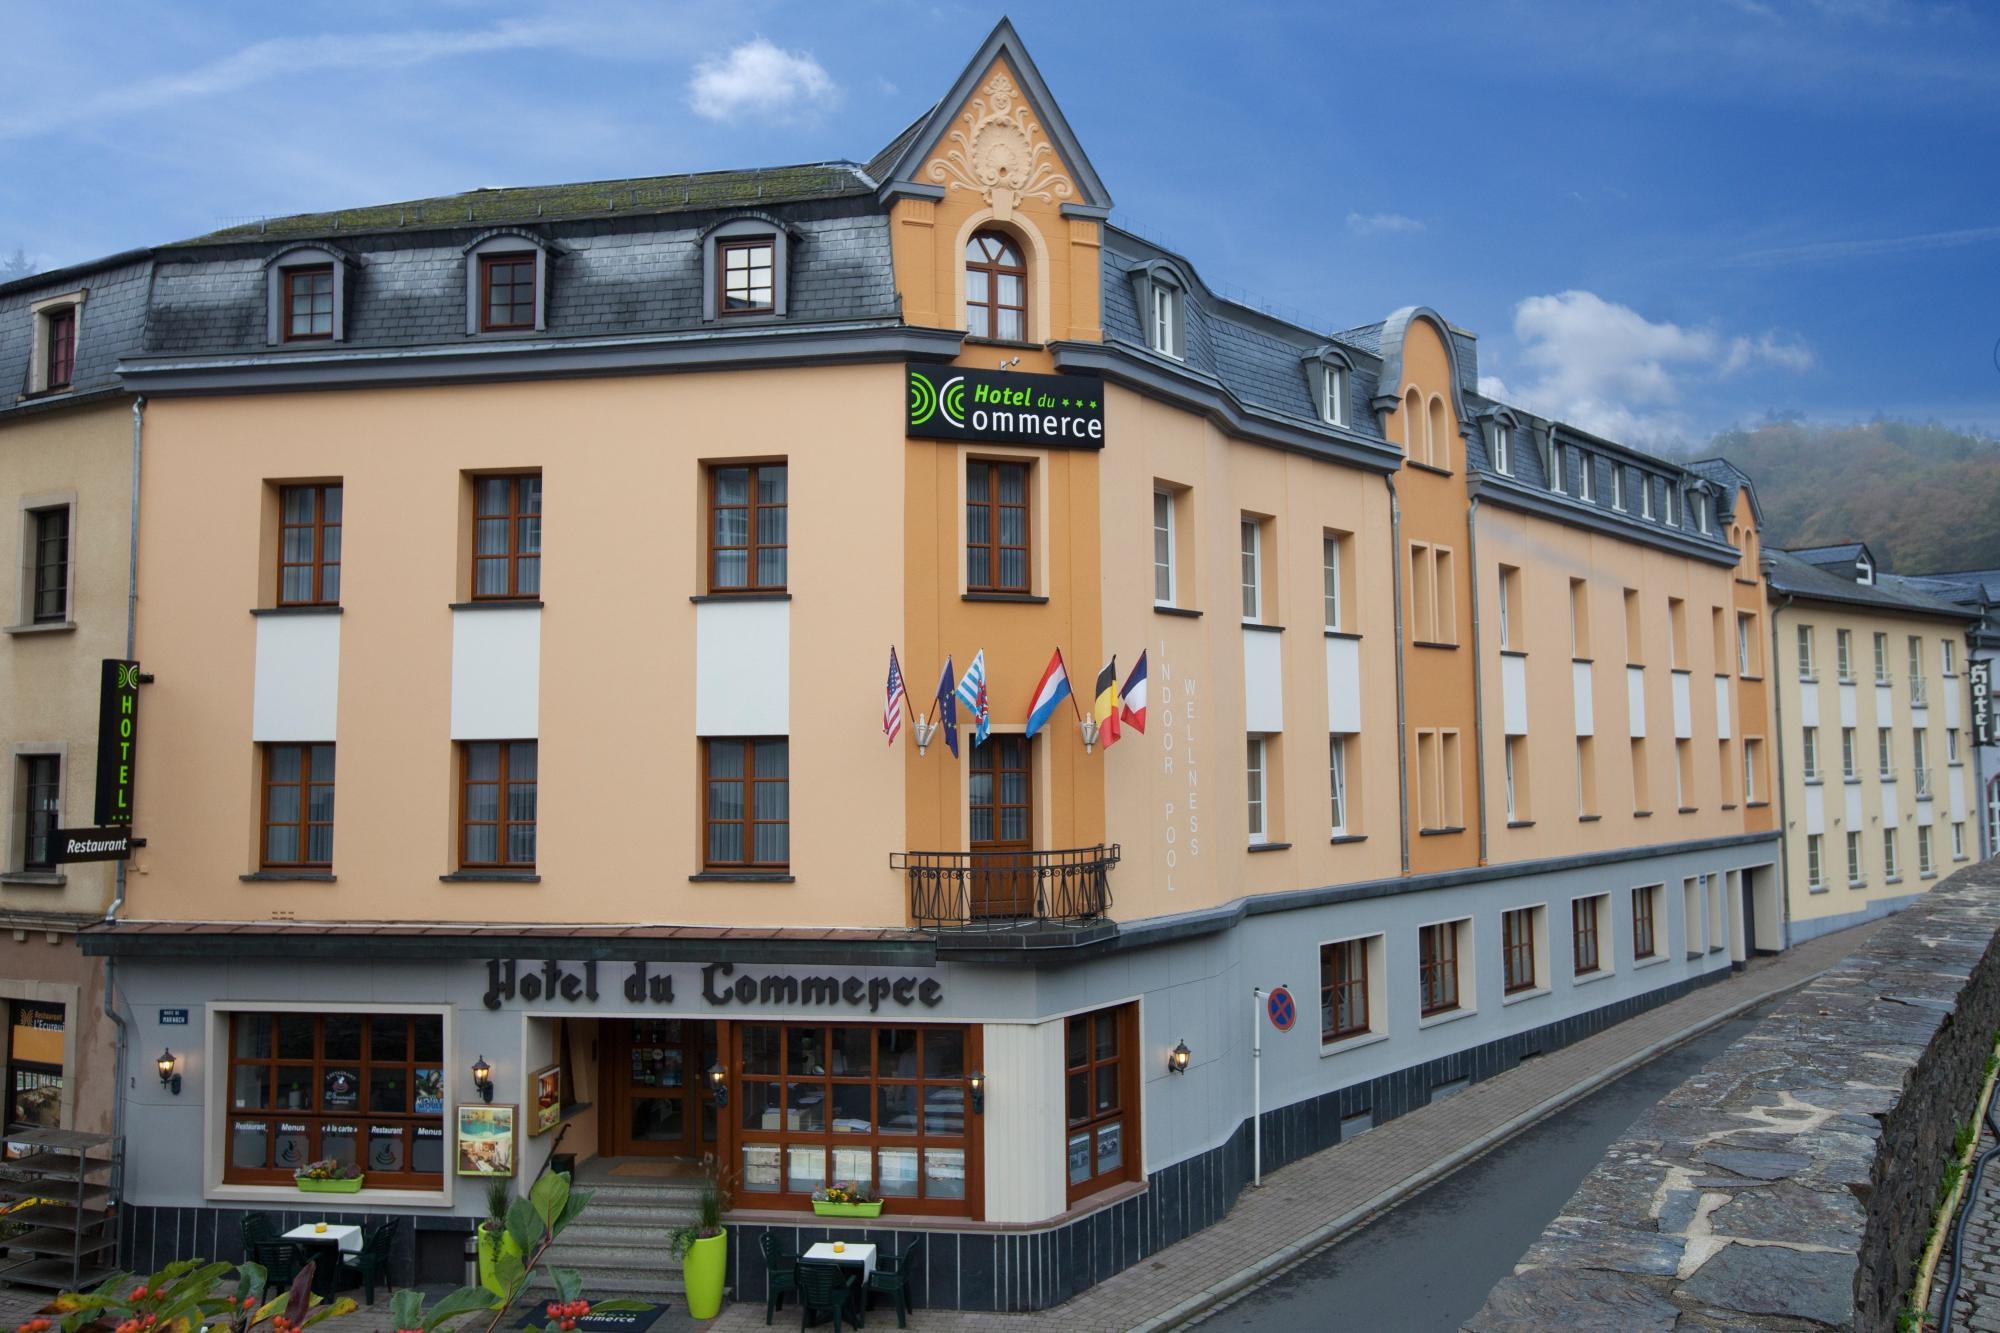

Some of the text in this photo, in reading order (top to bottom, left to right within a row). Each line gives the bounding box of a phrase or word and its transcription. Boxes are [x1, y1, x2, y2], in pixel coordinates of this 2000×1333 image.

[975, 384, 1056, 408] Hotel du
[118, 695, 132, 808] HOTEL
[1161, 639, 1176, 892] INDOOR POOL
[1184, 679, 1198, 856] WELLNESS
[67, 837, 128, 854] Restaurant
[483, 959, 944, 1013] Hotel du Commerce
[235, 1122, 266, 1131] Restaurant
[281, 1123, 305, 1132] Menus
[371, 1126, 403, 1134] Restaurant
[418, 1127, 442, 1136] Menus
